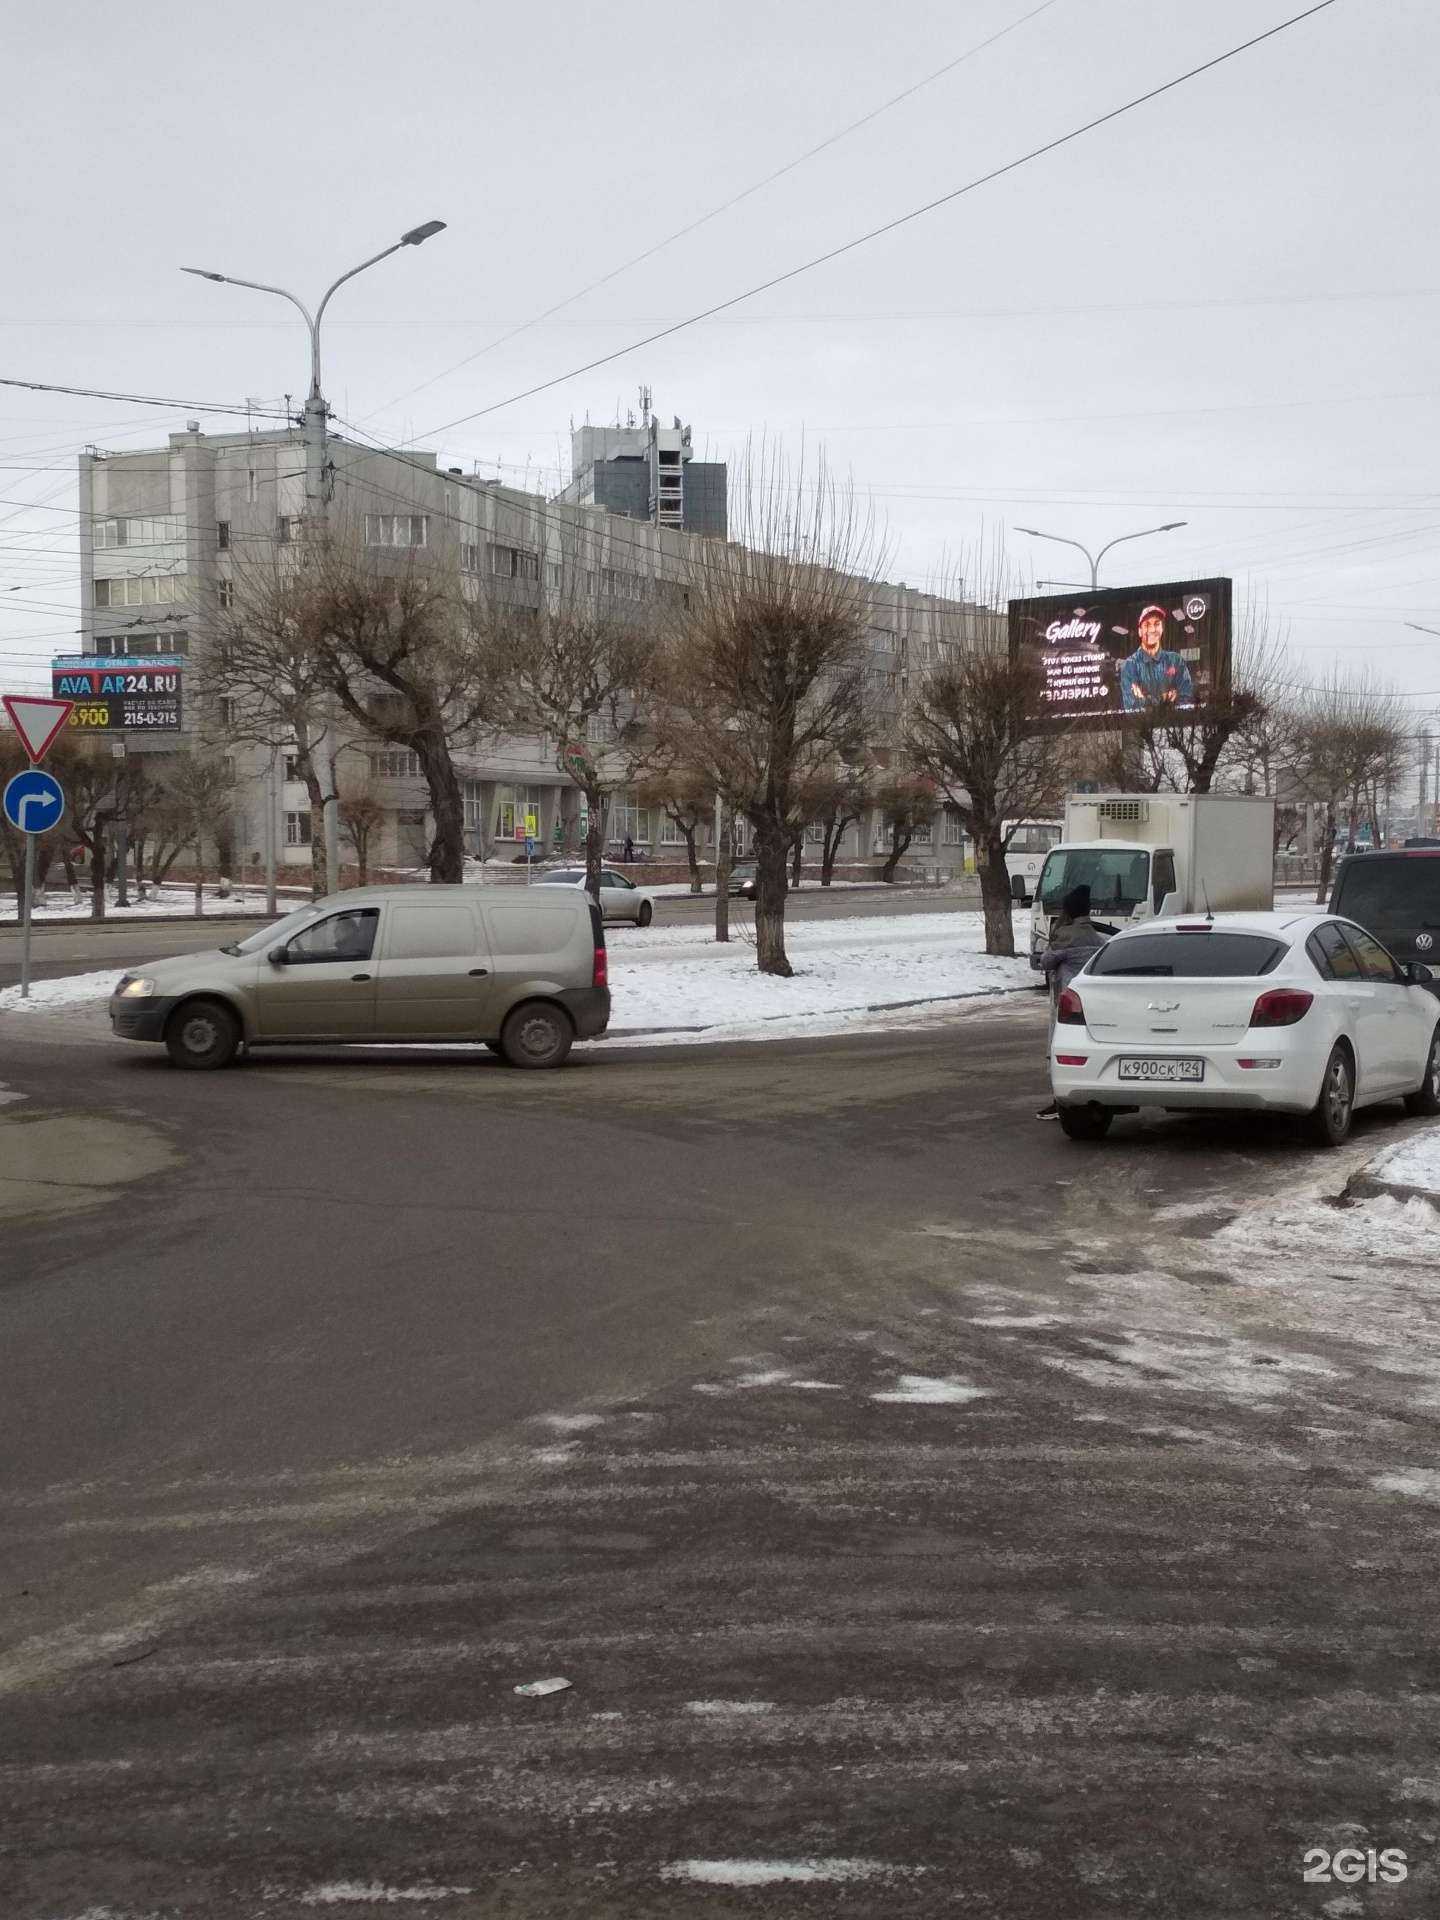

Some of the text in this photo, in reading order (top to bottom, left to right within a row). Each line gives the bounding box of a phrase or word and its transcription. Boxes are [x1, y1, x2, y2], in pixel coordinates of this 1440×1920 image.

[1046, 619, 1101, 644] Gallery
[124, 712, 177, 725] 215-0-215
[1179, 1062, 1199, 1073] 124
